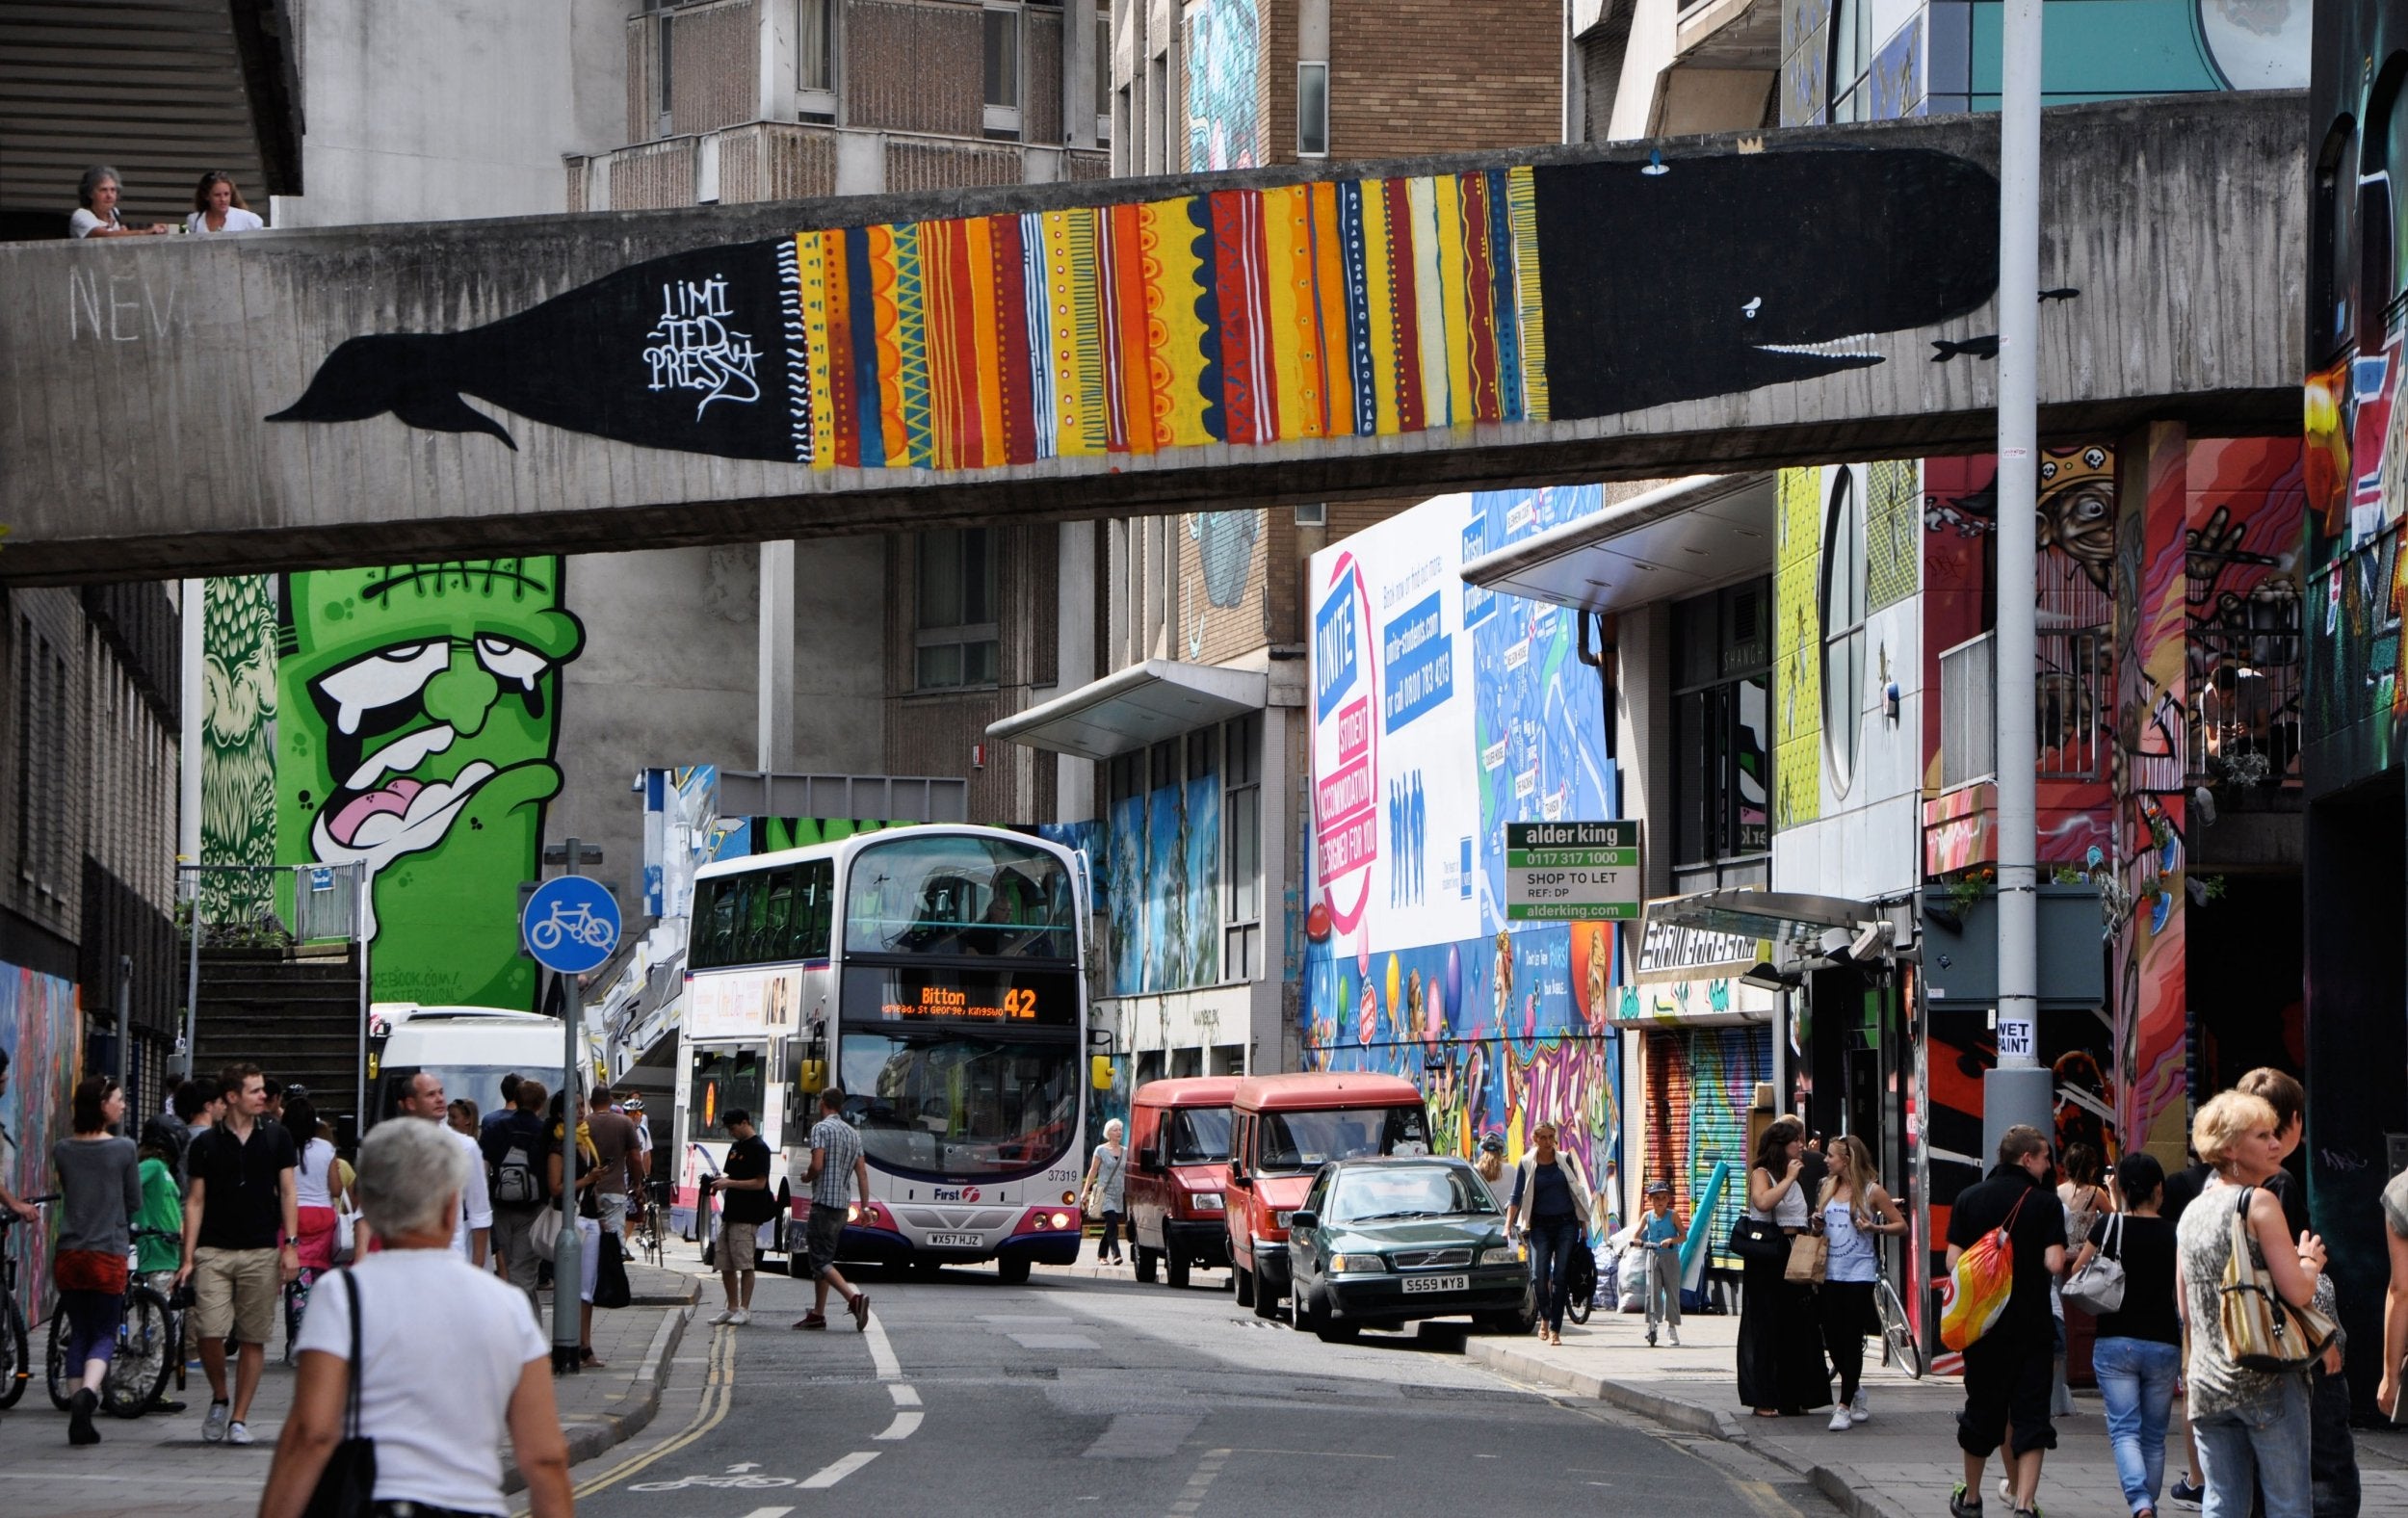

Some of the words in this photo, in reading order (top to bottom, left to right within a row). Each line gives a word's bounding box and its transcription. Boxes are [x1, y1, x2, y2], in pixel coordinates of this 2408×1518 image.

[1320, 592, 1353, 696] UNITE
[1386, 611, 1439, 666] unite-students.com
[1387, 694, 1394, 719] or
[1394, 678, 1404, 715] call
[1404, 669, 1421, 707] 0800
[1422, 661, 1434, 697] 783
[1340, 707, 1368, 754] STUDENT
[1320, 765, 1370, 824] ACCOMMODATION
[1527, 824, 1575, 843] alder
[1578, 824, 1618, 847] king
[1320, 832, 1348, 877] DESIGNED
[1349, 825, 1362, 861] FOR
[1363, 817, 1375, 855] YOU
[1527, 852, 1557, 865] 0117
[1560, 852, 1583, 864] 317
[1587, 851, 1618, 864] 1000
[1528, 873, 1565, 884] SHOP
[1569, 873, 1587, 883] TO
[1592, 873, 1617, 883] LET
[1529, 888, 1552, 898] REF:
[1555, 888, 1569, 897] DP
[1528, 904, 1619, 918] alderking.com
[922, 987, 965, 1005] Bitton
[1005, 989, 1036, 1018] 42
[918, 1006, 928, 1014] St
[930, 1006, 966, 1016] George,
[1998, 1023, 2028, 1036] WET
[1048, 1170, 1077, 1182] 37319
[934, 1189, 959, 1201] First
[932, 1235, 956, 1244] WX57
[959, 1235, 979, 1245] HJZ
[1406, 1279, 1437, 1291] S559
